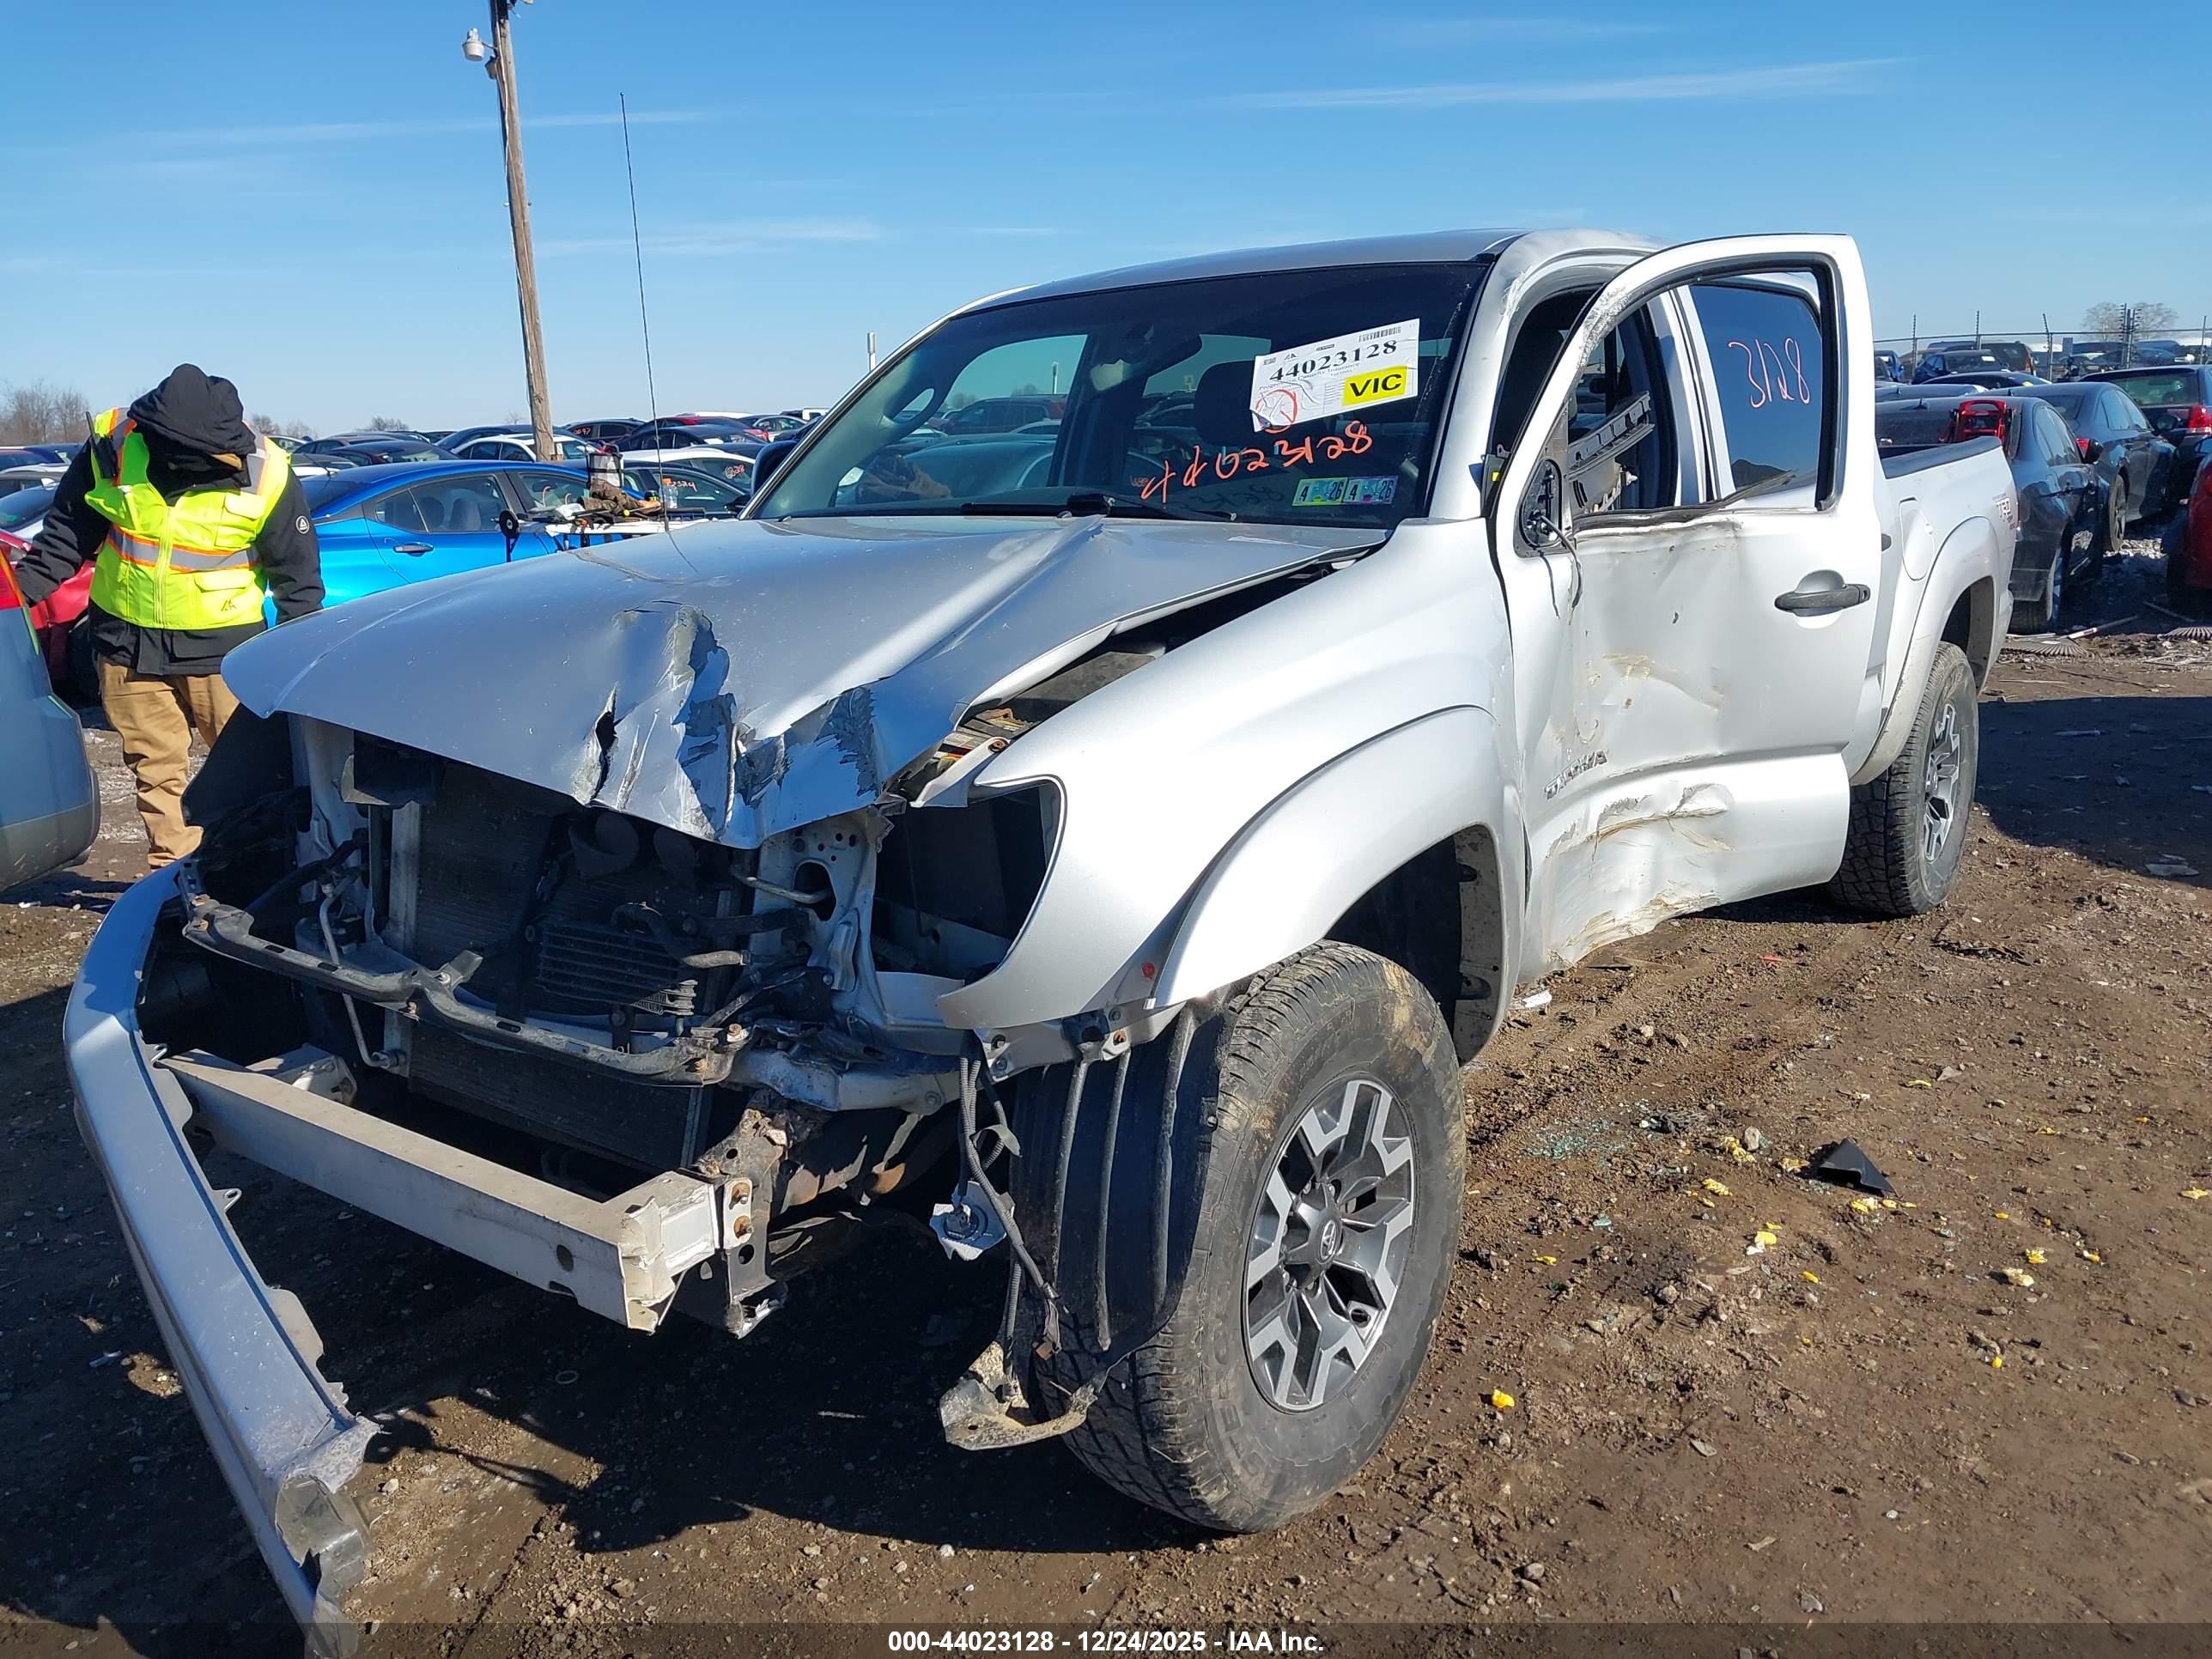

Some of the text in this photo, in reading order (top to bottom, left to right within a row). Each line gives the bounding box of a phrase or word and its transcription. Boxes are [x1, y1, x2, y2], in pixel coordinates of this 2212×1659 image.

[1269, 340, 1397, 380] 44023128
[1729, 338, 1810, 408] 3128
[1350, 374, 1402, 397] VIC
[1140, 420, 1373, 504] 44023128
[1299, 485, 1309, 501] 4
[1328, 481, 1344, 501] 26
[1348, 479, 1394, 501] 4 26
